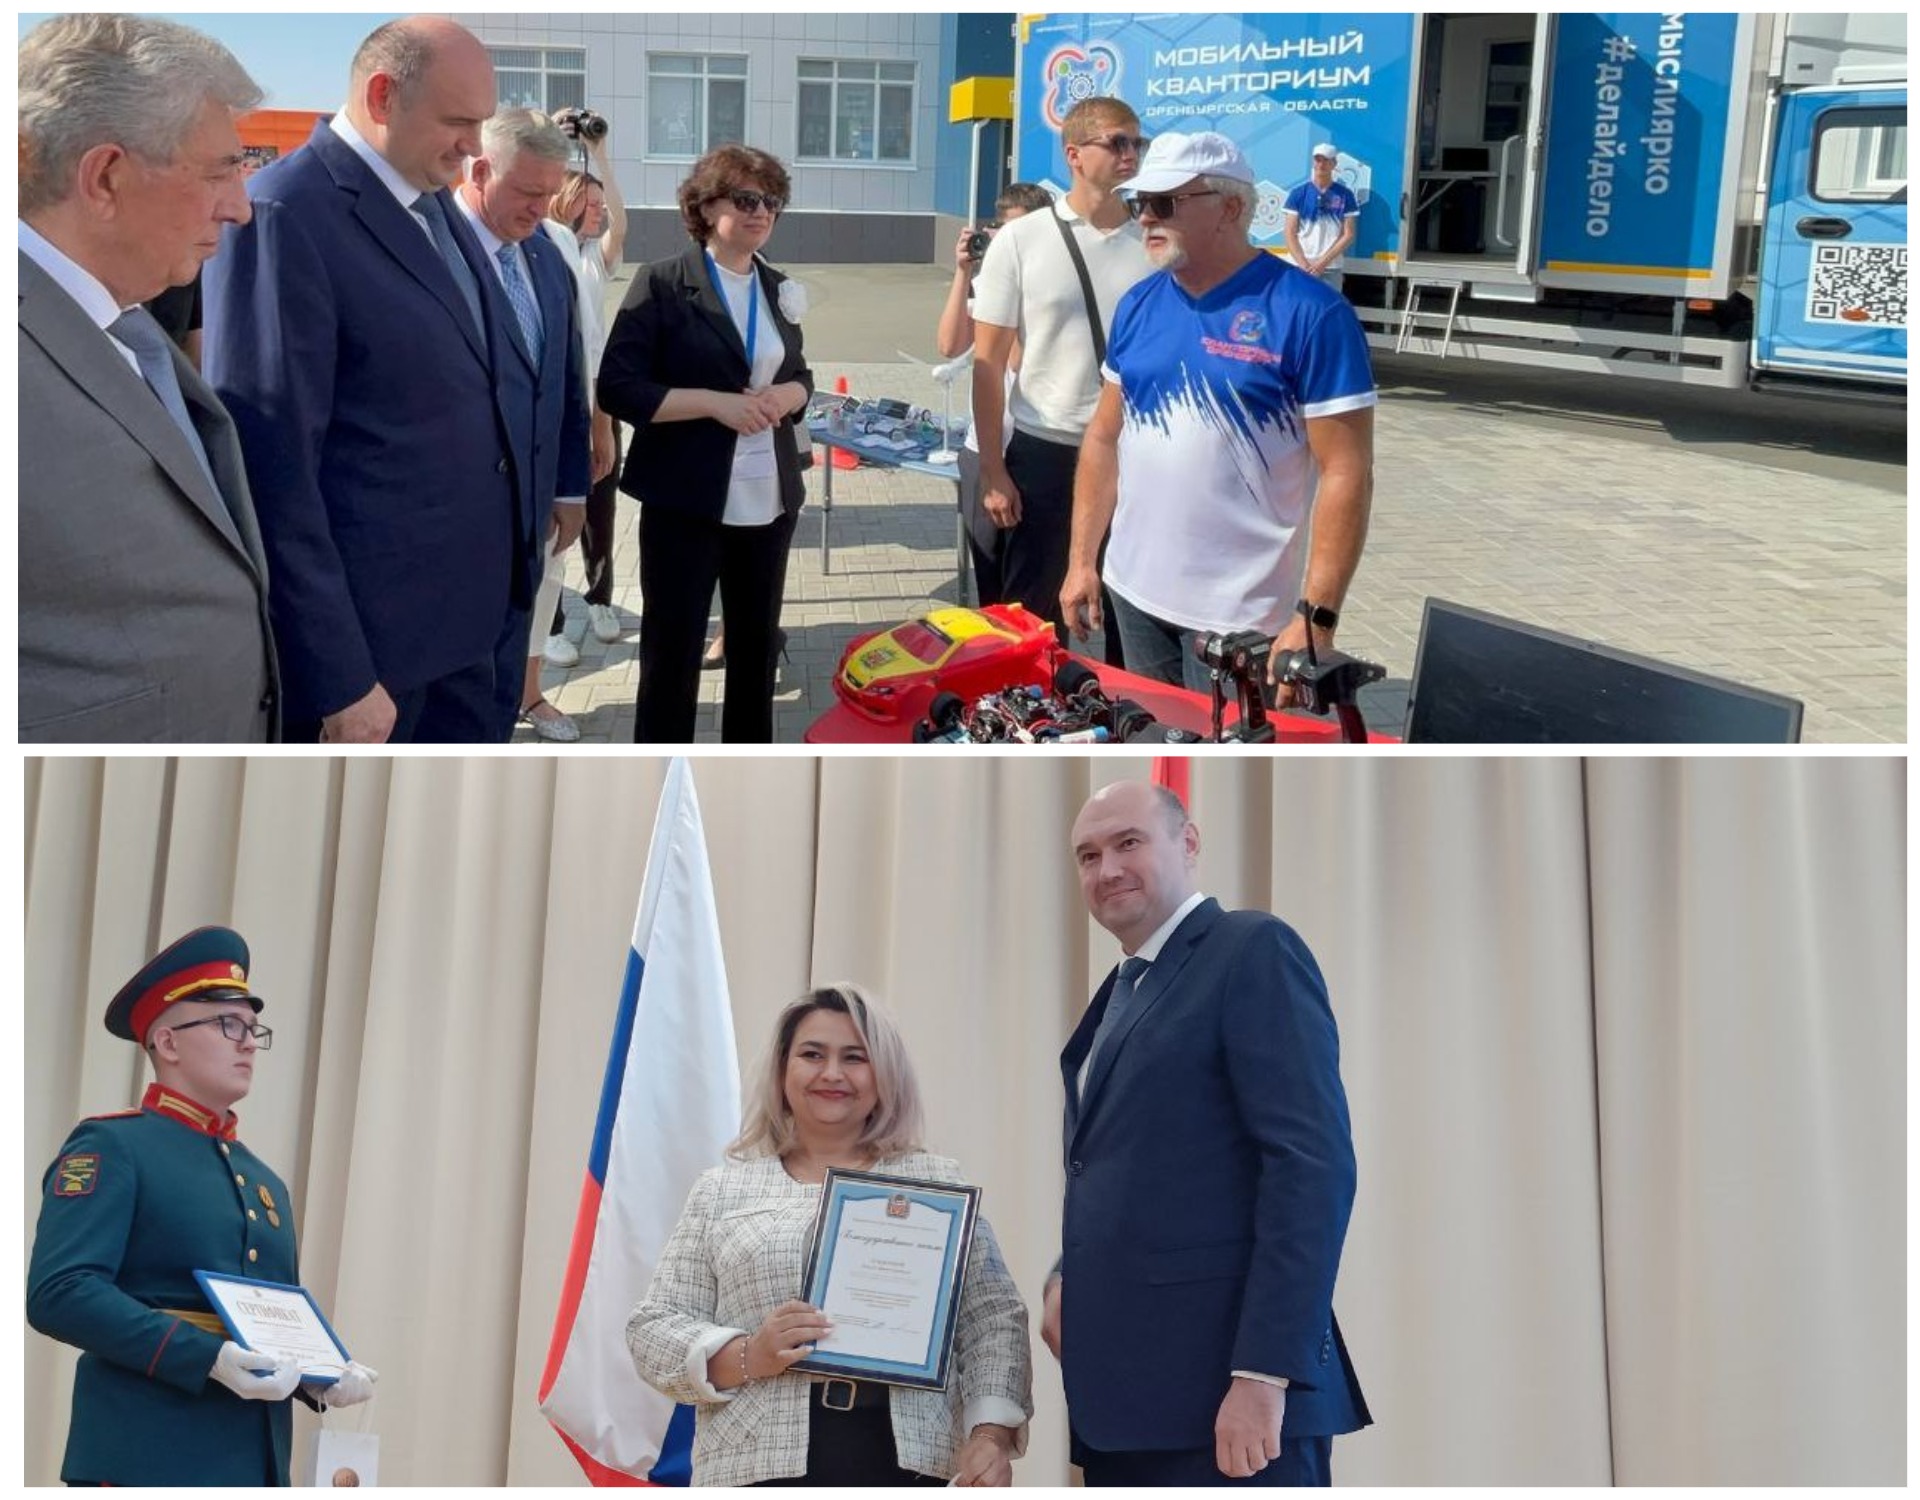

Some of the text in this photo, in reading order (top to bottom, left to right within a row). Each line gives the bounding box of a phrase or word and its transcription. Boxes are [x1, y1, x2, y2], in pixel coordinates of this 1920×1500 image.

[1154, 31, 1364, 69] МОБИЛЬНЫЙ
[1146, 65, 1370, 97] КВАНТОРИУМ
[1146, 97, 1368, 117] ОРЕНБУРГСКАЯ ОБЛАСТЬ
[1586, 35, 1637, 237] #делайдело
